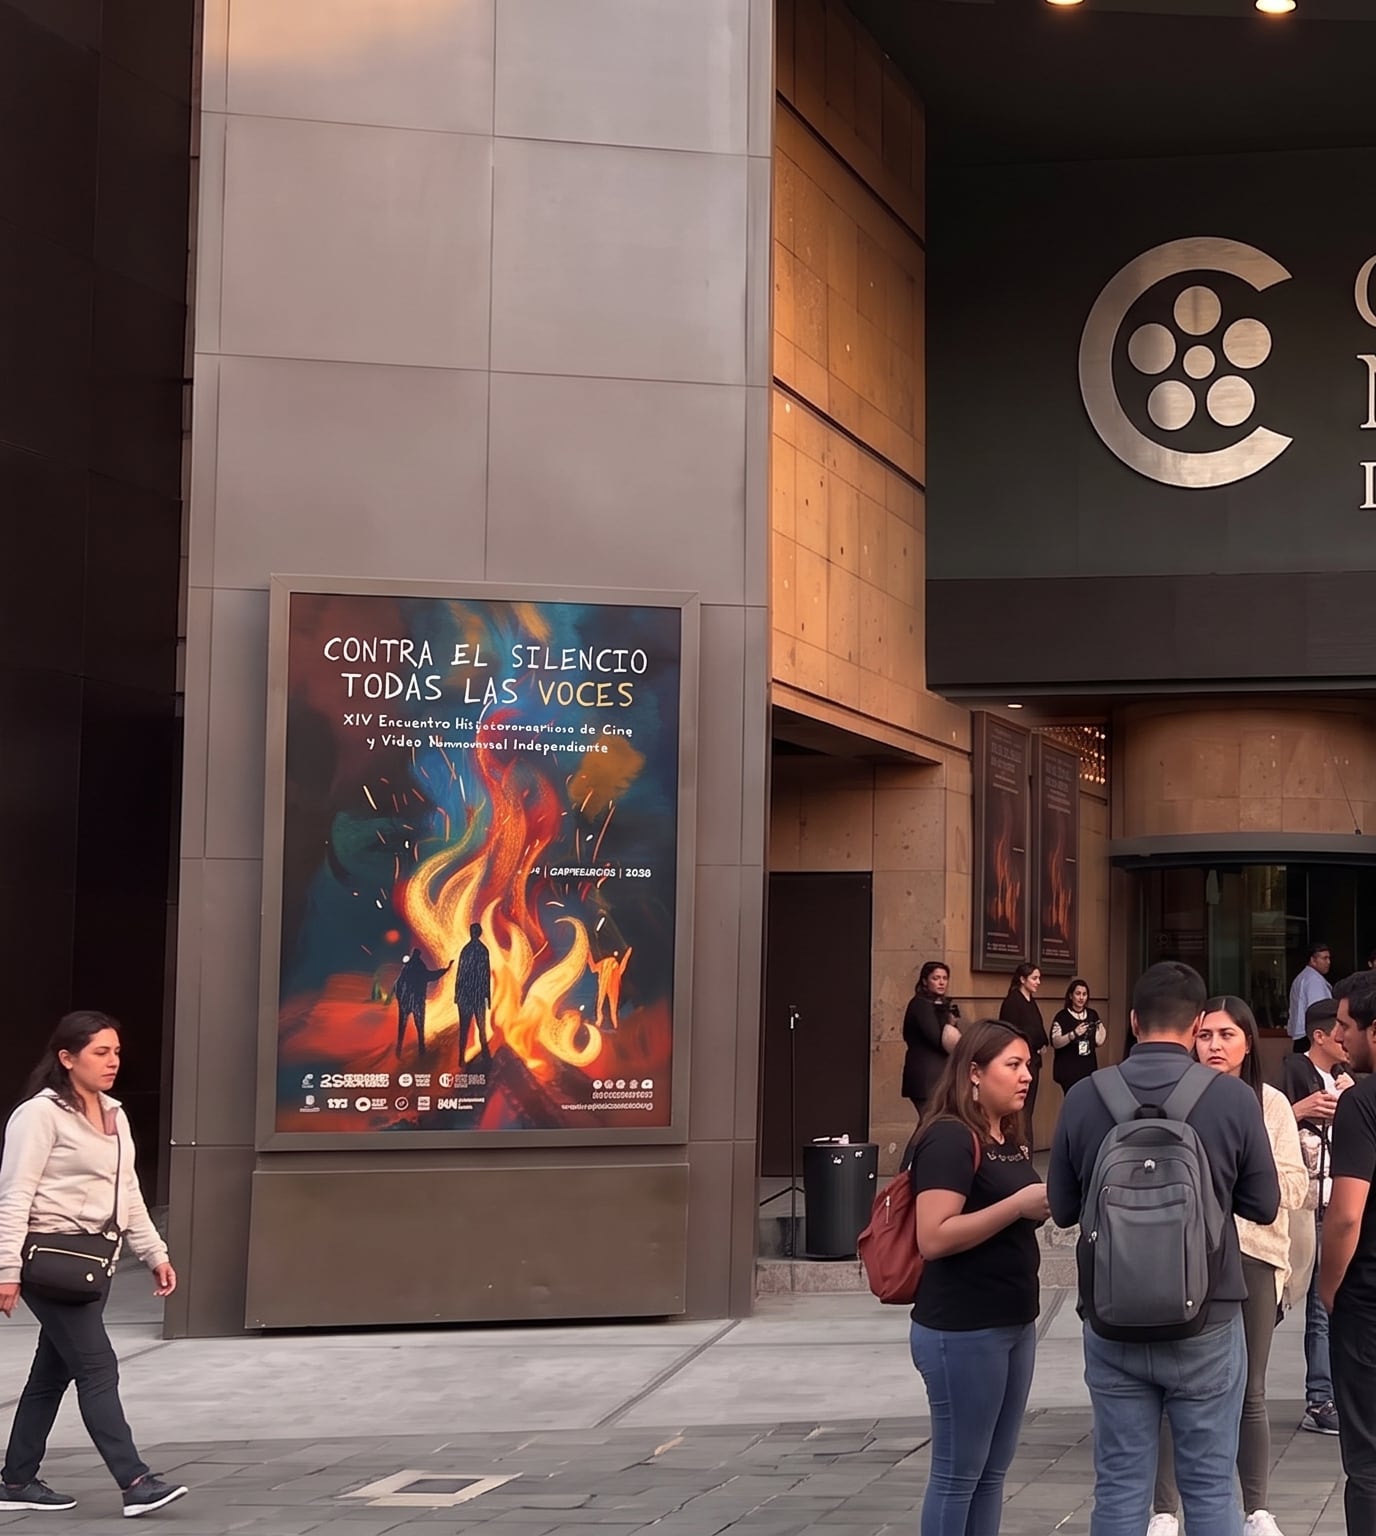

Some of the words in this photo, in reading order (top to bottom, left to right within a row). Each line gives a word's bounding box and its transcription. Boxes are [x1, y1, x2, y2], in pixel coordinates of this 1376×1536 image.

[323, 637, 433, 669] CONTRA
[451, 643, 488, 667] EL
[511, 644, 648, 674] SILENCIO
[341, 672, 442, 701] TODAS
[464, 677, 518, 704] LAS
[538, 680, 634, 707] VOCES
[343, 714, 373, 727] XIV
[379, 714, 451, 730] Encuentro
[580, 724, 596, 735] de
[366, 737, 375, 750] y
[381, 734, 422, 748] Video
